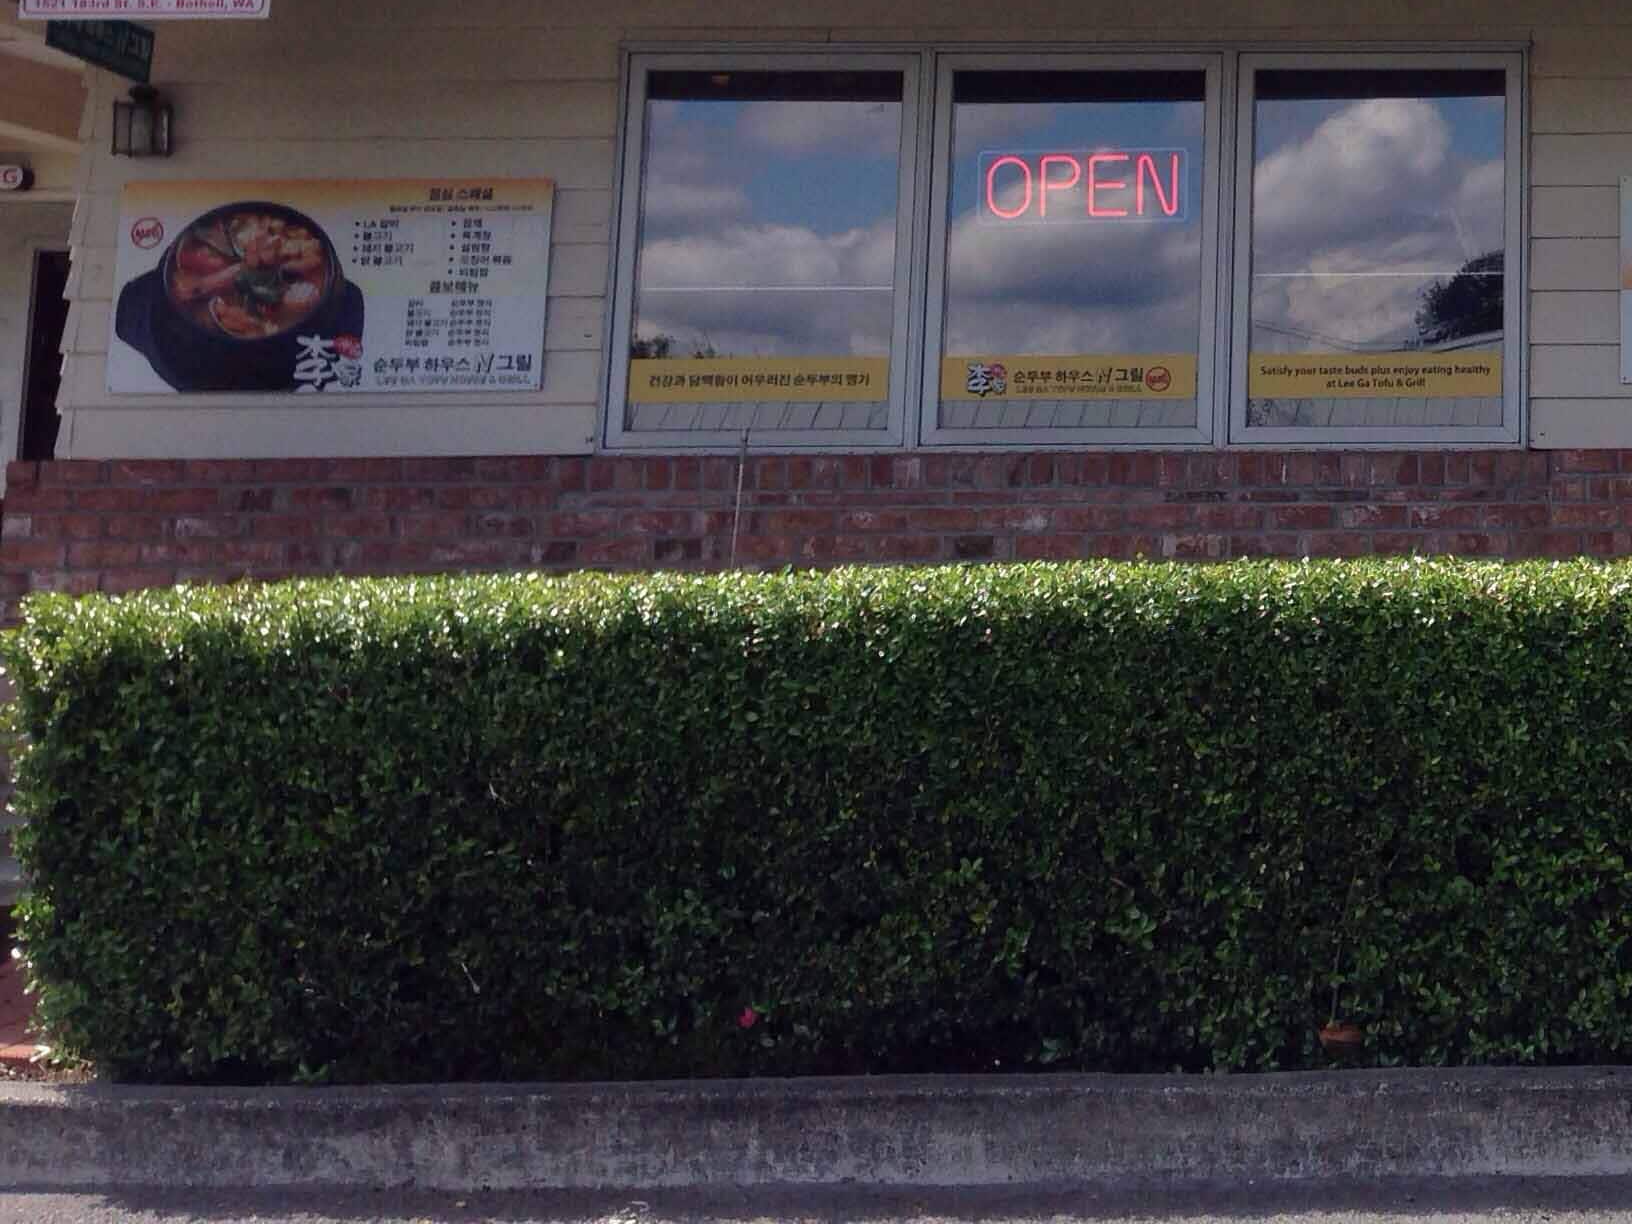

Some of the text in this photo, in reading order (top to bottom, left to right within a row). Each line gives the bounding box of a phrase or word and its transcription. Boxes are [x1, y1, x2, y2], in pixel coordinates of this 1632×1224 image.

[985, 152, 1179, 219] OPEN
[374, 357, 420, 373] 순두부
[424, 356, 471, 373] 하우스
[496, 353, 532, 372] 그릴
[1260, 365, 1293, 376] Satisfy
[1295, 368, 1316, 377] your
[1319, 366, 1343, 375] taste
[1371, 365, 1391, 377] plus
[1393, 366, 1419, 376] enjoy
[1421, 366, 1452, 376] eating
[1454, 365, 1490, 376] healthy
[1014, 368, 1053, 384] 순두부
[1056, 368, 1094, 383] 하우스
[1338, 378, 1355, 388] Lee
